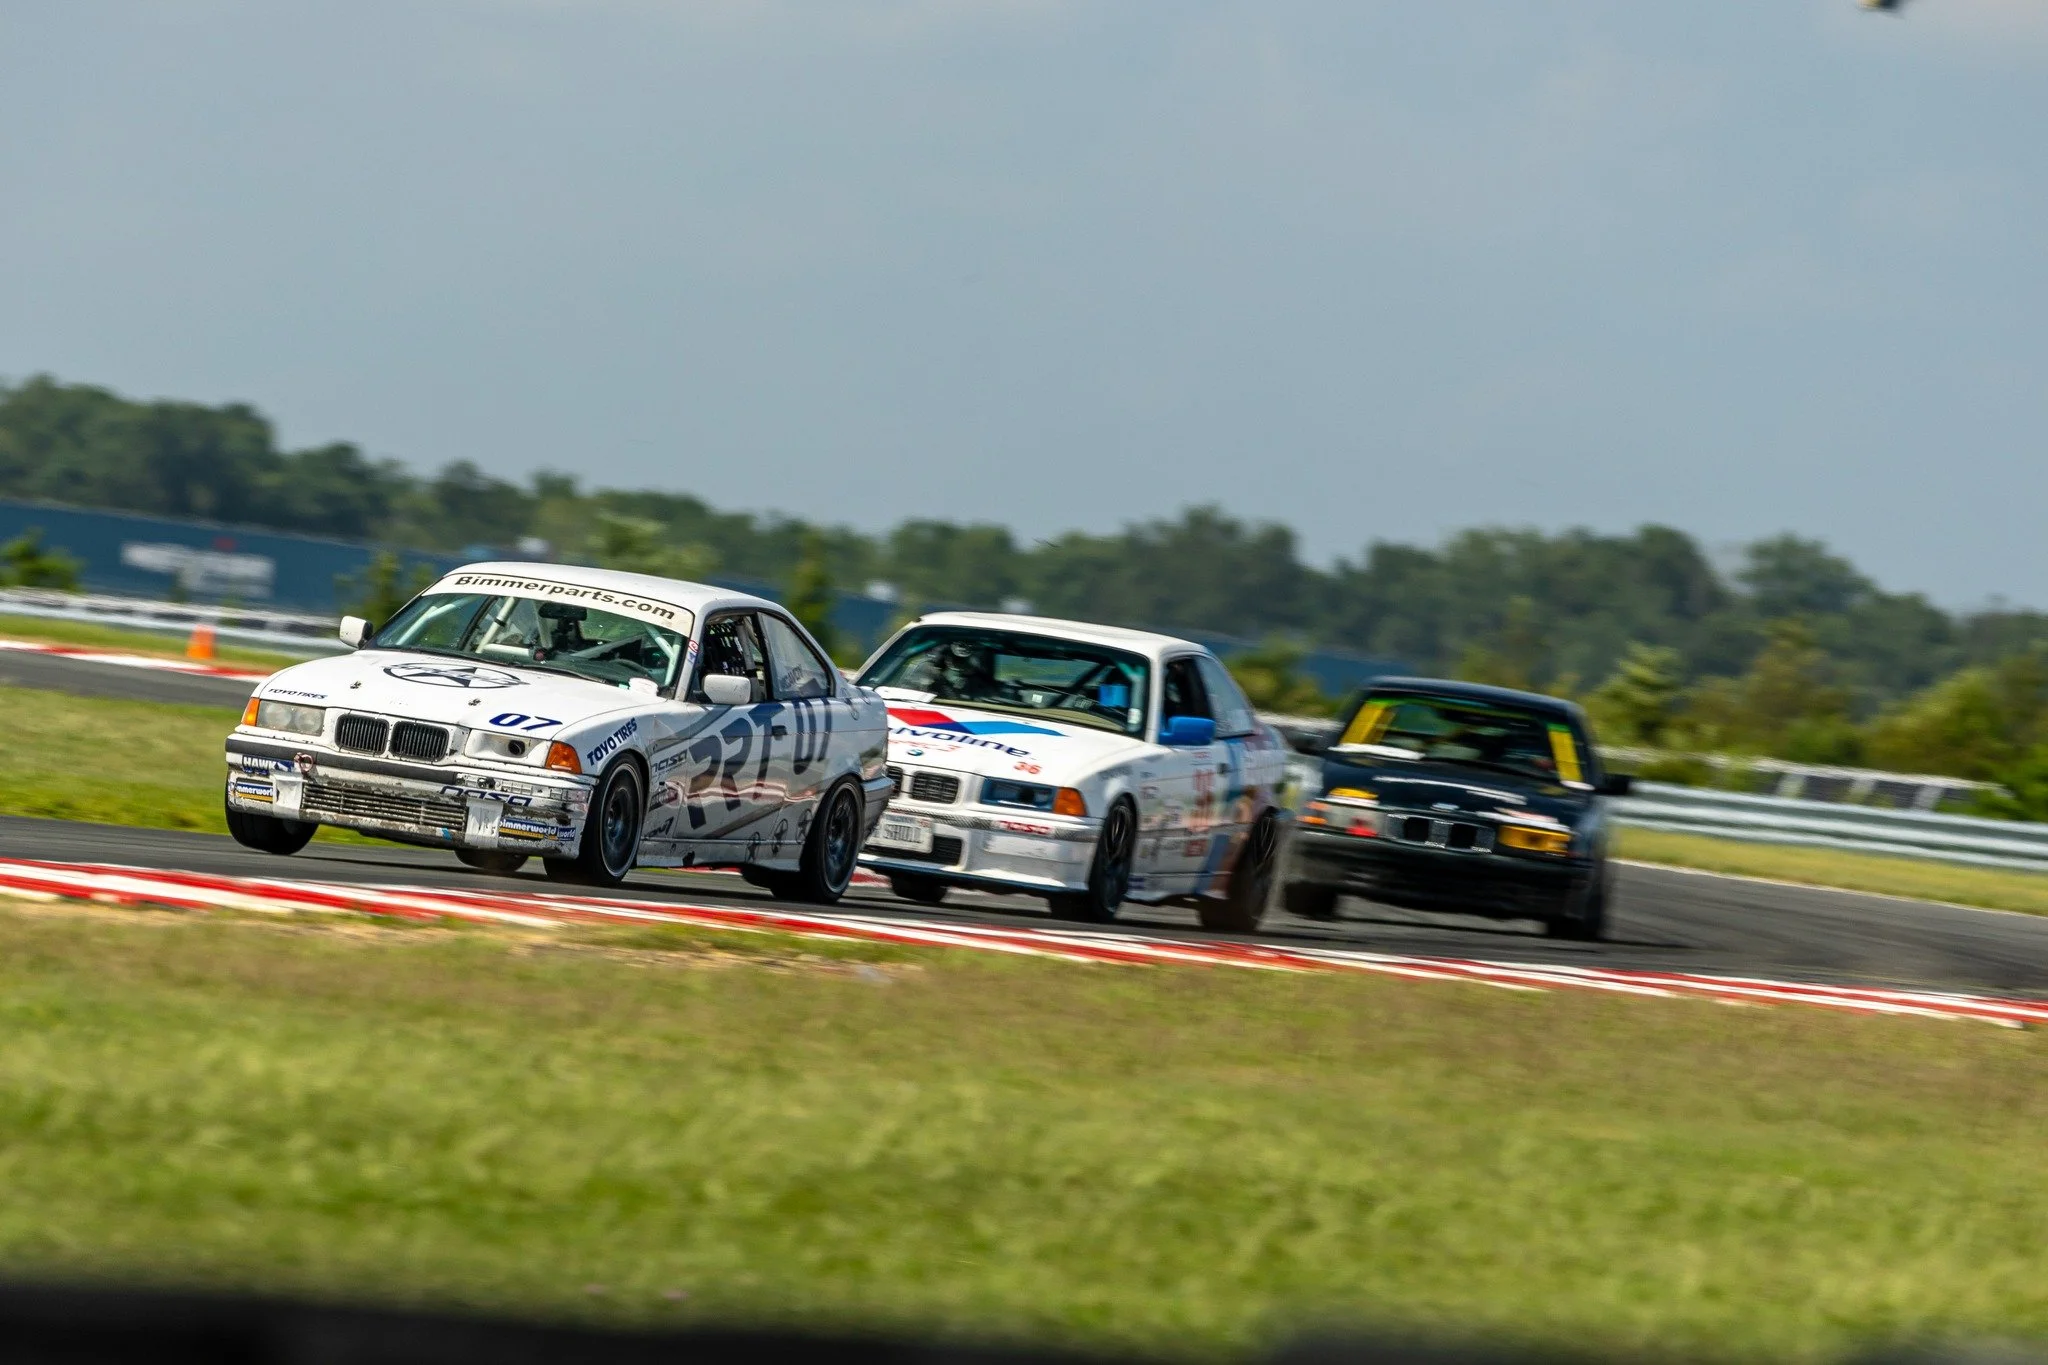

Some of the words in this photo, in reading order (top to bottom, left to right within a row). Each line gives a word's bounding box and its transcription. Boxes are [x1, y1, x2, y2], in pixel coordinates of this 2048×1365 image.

[455, 575, 676, 620] Bimmerparts.com
[489, 712, 564, 731] 07
[586, 736, 617, 766] TOYO
[613, 717, 638, 744] TIRES
[888, 727, 1031, 757] lvoline
[243, 756, 277, 770] HAWK
[1013, 761, 1042, 775] 36
